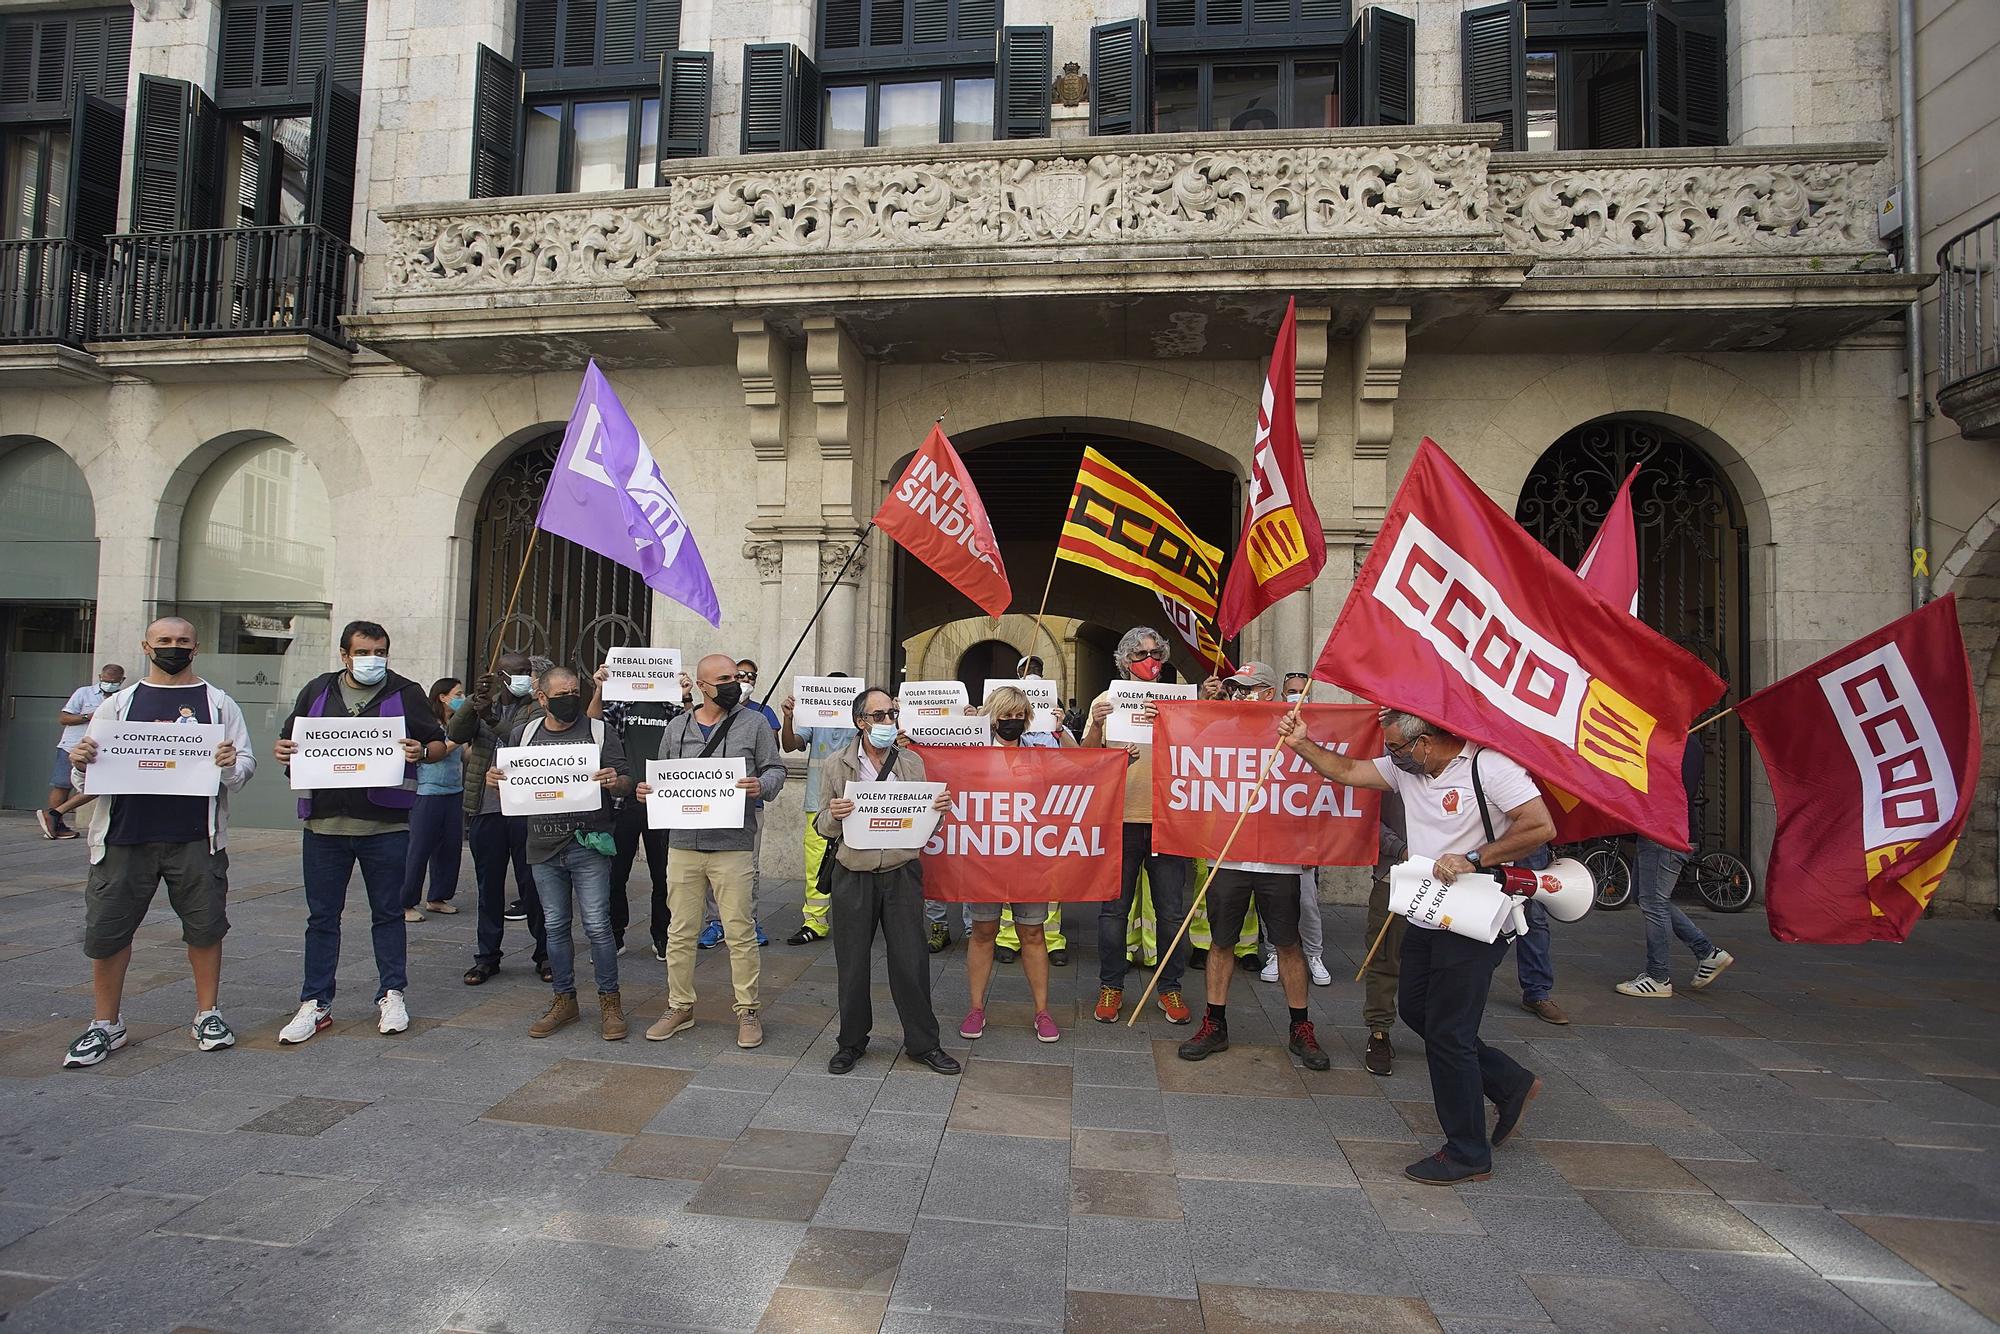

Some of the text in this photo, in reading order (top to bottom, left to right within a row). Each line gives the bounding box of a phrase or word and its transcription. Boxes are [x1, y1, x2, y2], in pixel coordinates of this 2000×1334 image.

[911, 455, 973, 519] INTE
[1395, 542, 1569, 717] CCOO
[612, 657, 647, 665] TREBALL
[611, 670, 675, 679] TREBALL SEGUR
[801, 685, 856, 694] TREBALL DIGNE
[904, 689, 927, 697] VOLEM
[1041, 689, 1049, 697] SI
[1117, 691, 1187, 700] VOLEM REBALLAR
[801, 698, 852, 707] TREBALL SEGU
[923, 698, 958, 706] SEGURETAT
[1120, 702, 1138, 710] AMB
[638, 716, 668, 727] humme
[305, 728, 392, 740] NEGOCIACIÓ SI
[911, 726, 983, 736] NEGOCIACIÓ SI
[122, 733, 203, 743] CONTRACTACIÓ
[1841, 664, 1940, 828] CCOO
[111, 747, 162, 756] QUALITAT
[164, 748, 177, 756] DE
[179, 749, 211, 757] SERVEI
[304, 747, 394, 758] COACCIONS NO
[510, 755, 587, 768] NEGOCIACIÓ SI
[1169, 745, 1287, 781] INTER
[658, 769, 734, 780] NEGOCIACIÓ SI
[510, 774, 589, 786] COACCIONS NO
[658, 788, 735, 798] COACCIONS NO
[856, 792, 933, 801] VOLEM TREBALLAR
[1168, 778, 1362, 818] SINDICAL
[880, 806, 927, 814] SEGURETAT
[943, 791, 1038, 823] NTER
[870, 818, 901, 828] CCOO
[1424, 907, 1437, 921] DE
[1433, 882, 1451, 910] SERVE
